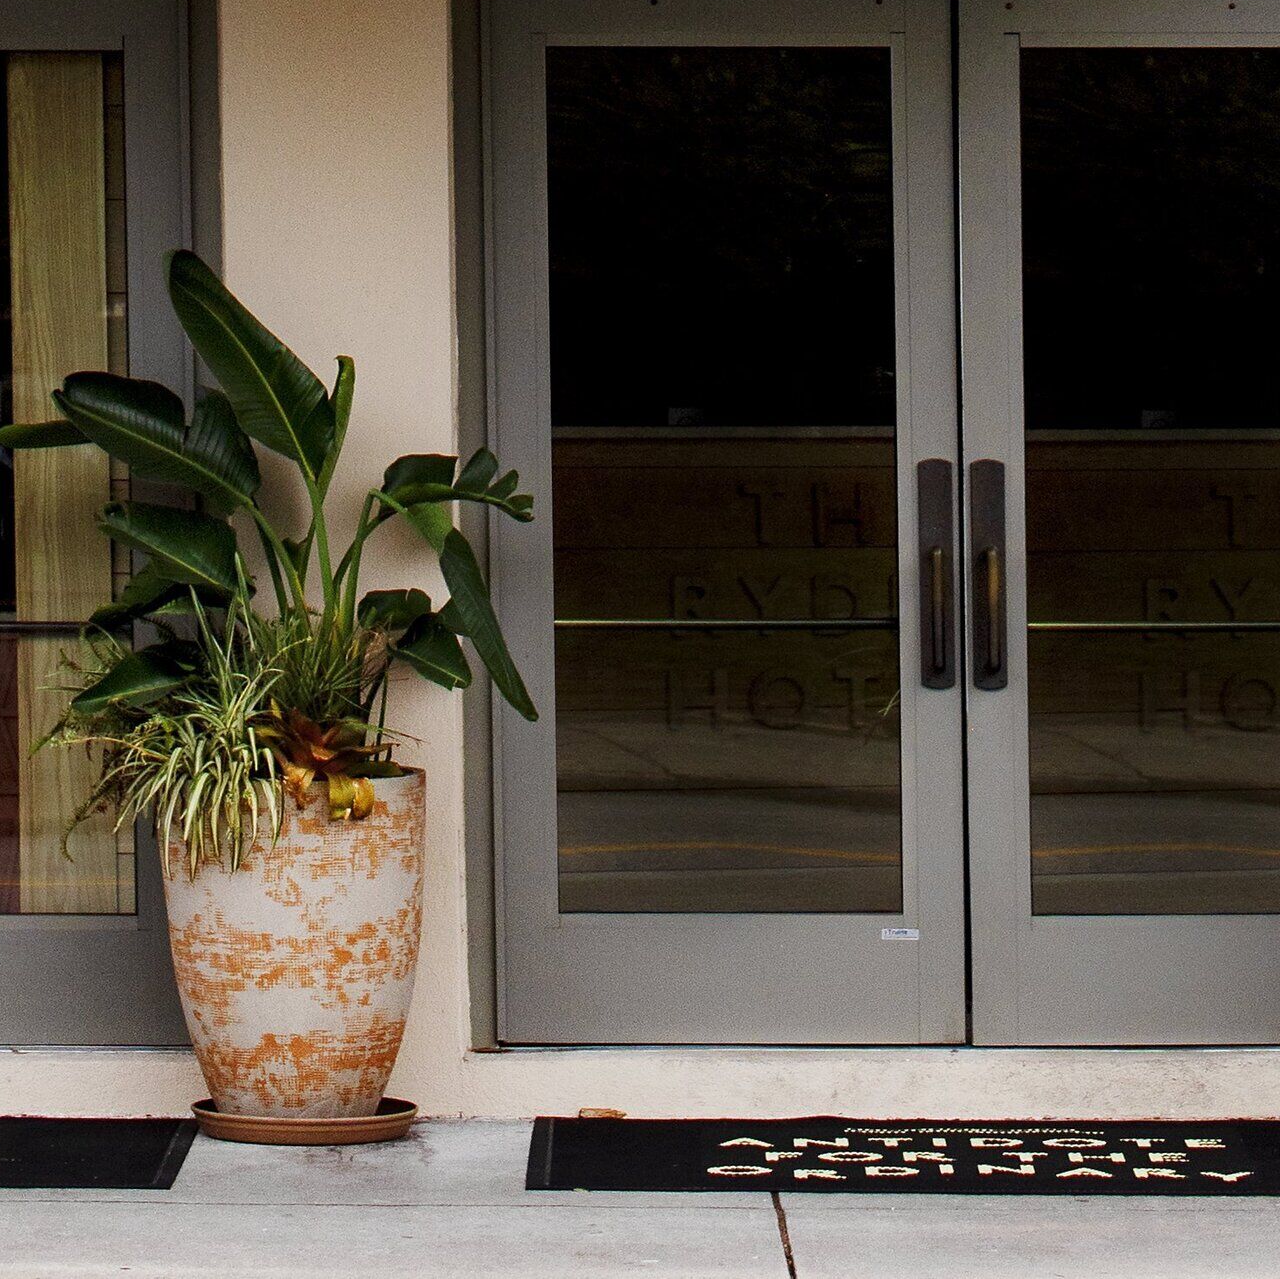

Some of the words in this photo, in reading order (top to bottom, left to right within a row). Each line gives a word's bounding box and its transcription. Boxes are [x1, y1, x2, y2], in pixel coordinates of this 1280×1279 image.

[734, 482, 868, 549] TH
[667, 574, 897, 639] RYD
[664, 666, 885, 733] HOT
[718, 1137, 1227, 1148] ANTIDOTE
[765, 1151, 958, 1162] FOR
[1002, 1152, 1190, 1163] THE
[706, 1163, 1255, 1182] ORDINARY
